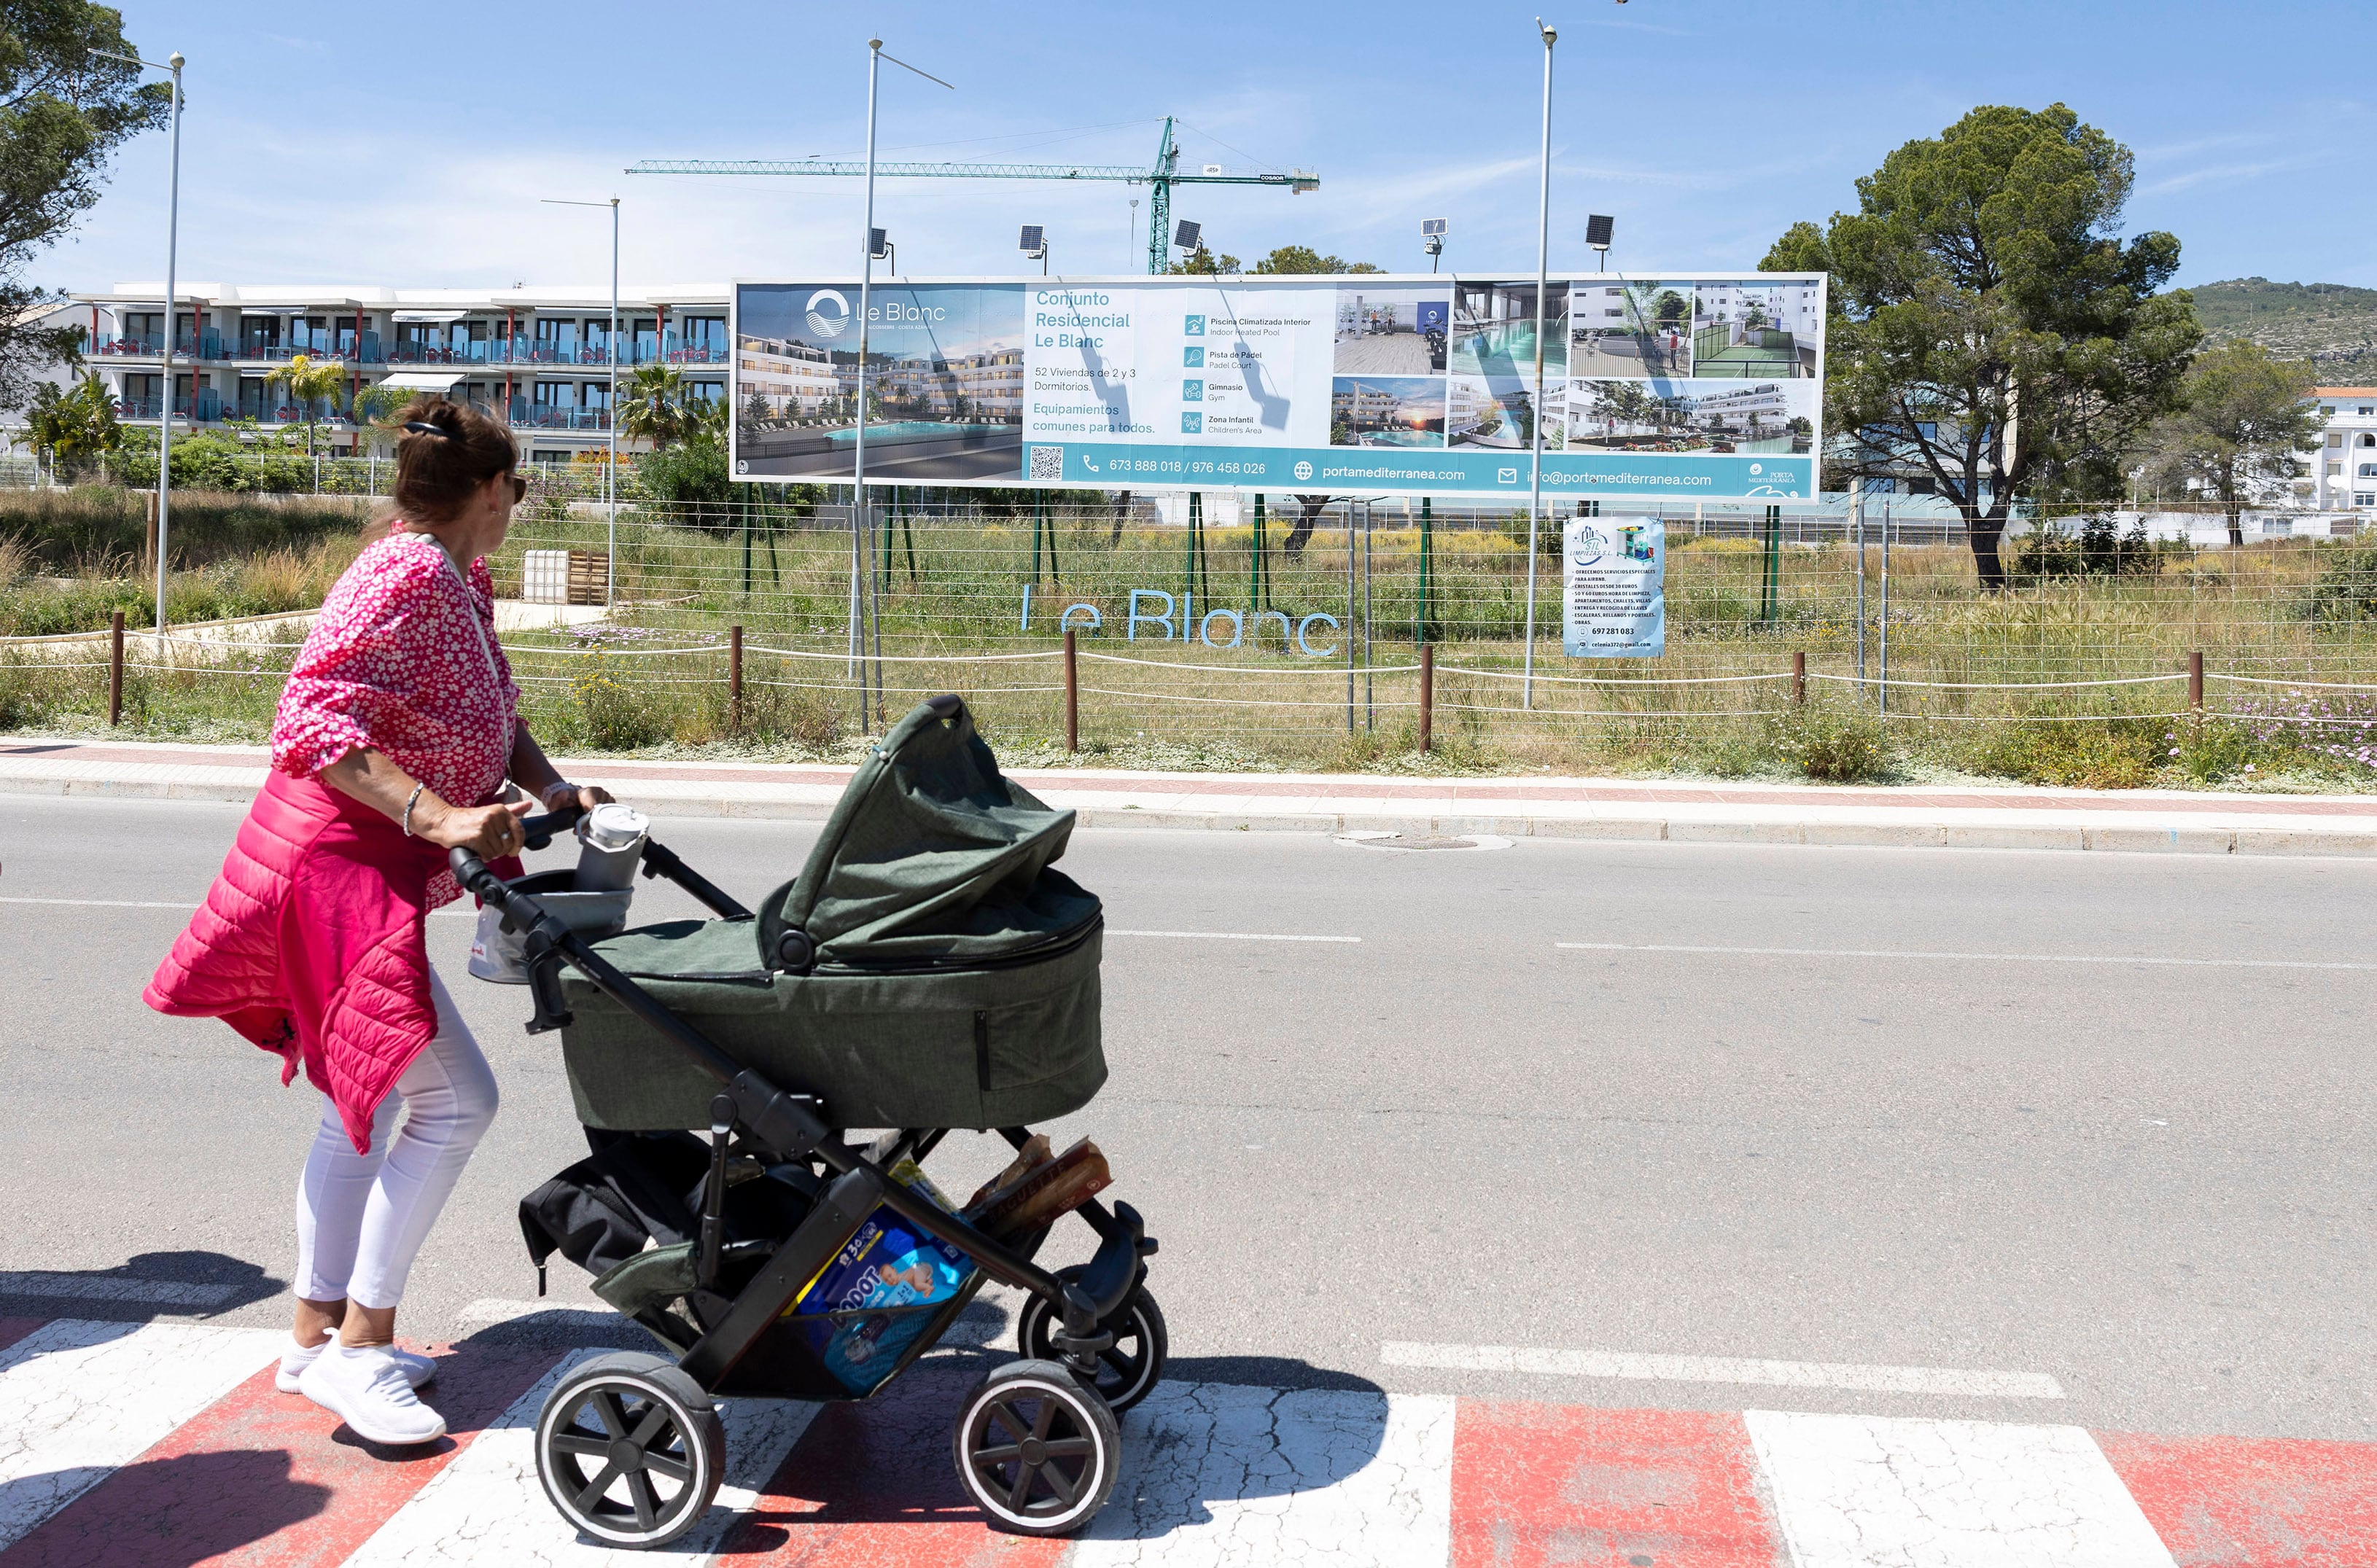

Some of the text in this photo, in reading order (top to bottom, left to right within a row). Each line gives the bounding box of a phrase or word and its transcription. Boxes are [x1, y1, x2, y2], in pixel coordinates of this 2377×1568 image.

[1037, 291, 1109, 308] Conjunto
[857, 303, 946, 321] Le Blanc
[1035, 312, 1129, 327] Residencial
[1239, 318, 1283, 326] Climatizada
[1035, 333, 1103, 348] Le Blanc
[1035, 367, 1136, 379] 52 Viviendas de 2 y 3
[1035, 381, 1091, 391] Dormitorios.
[1034, 403, 1119, 416] Equipamientos
[1032, 422, 1155, 434] comunes para todos.
[1109, 459, 1131, 471] 673
[1135, 460, 1157, 472] 888
[1160, 461, 1181, 472] 018
[1192, 461, 1214, 472] 976
[1217, 462, 1240, 473] 458
[1243, 463, 1266, 474] 026
[1323, 467, 1465, 480] portamediterranea.com
[1527, 470, 1711, 485] io@portamediterranea.com
[1586, 542, 1600, 550] SIL
[1128, 589, 1339, 656] Blanc
